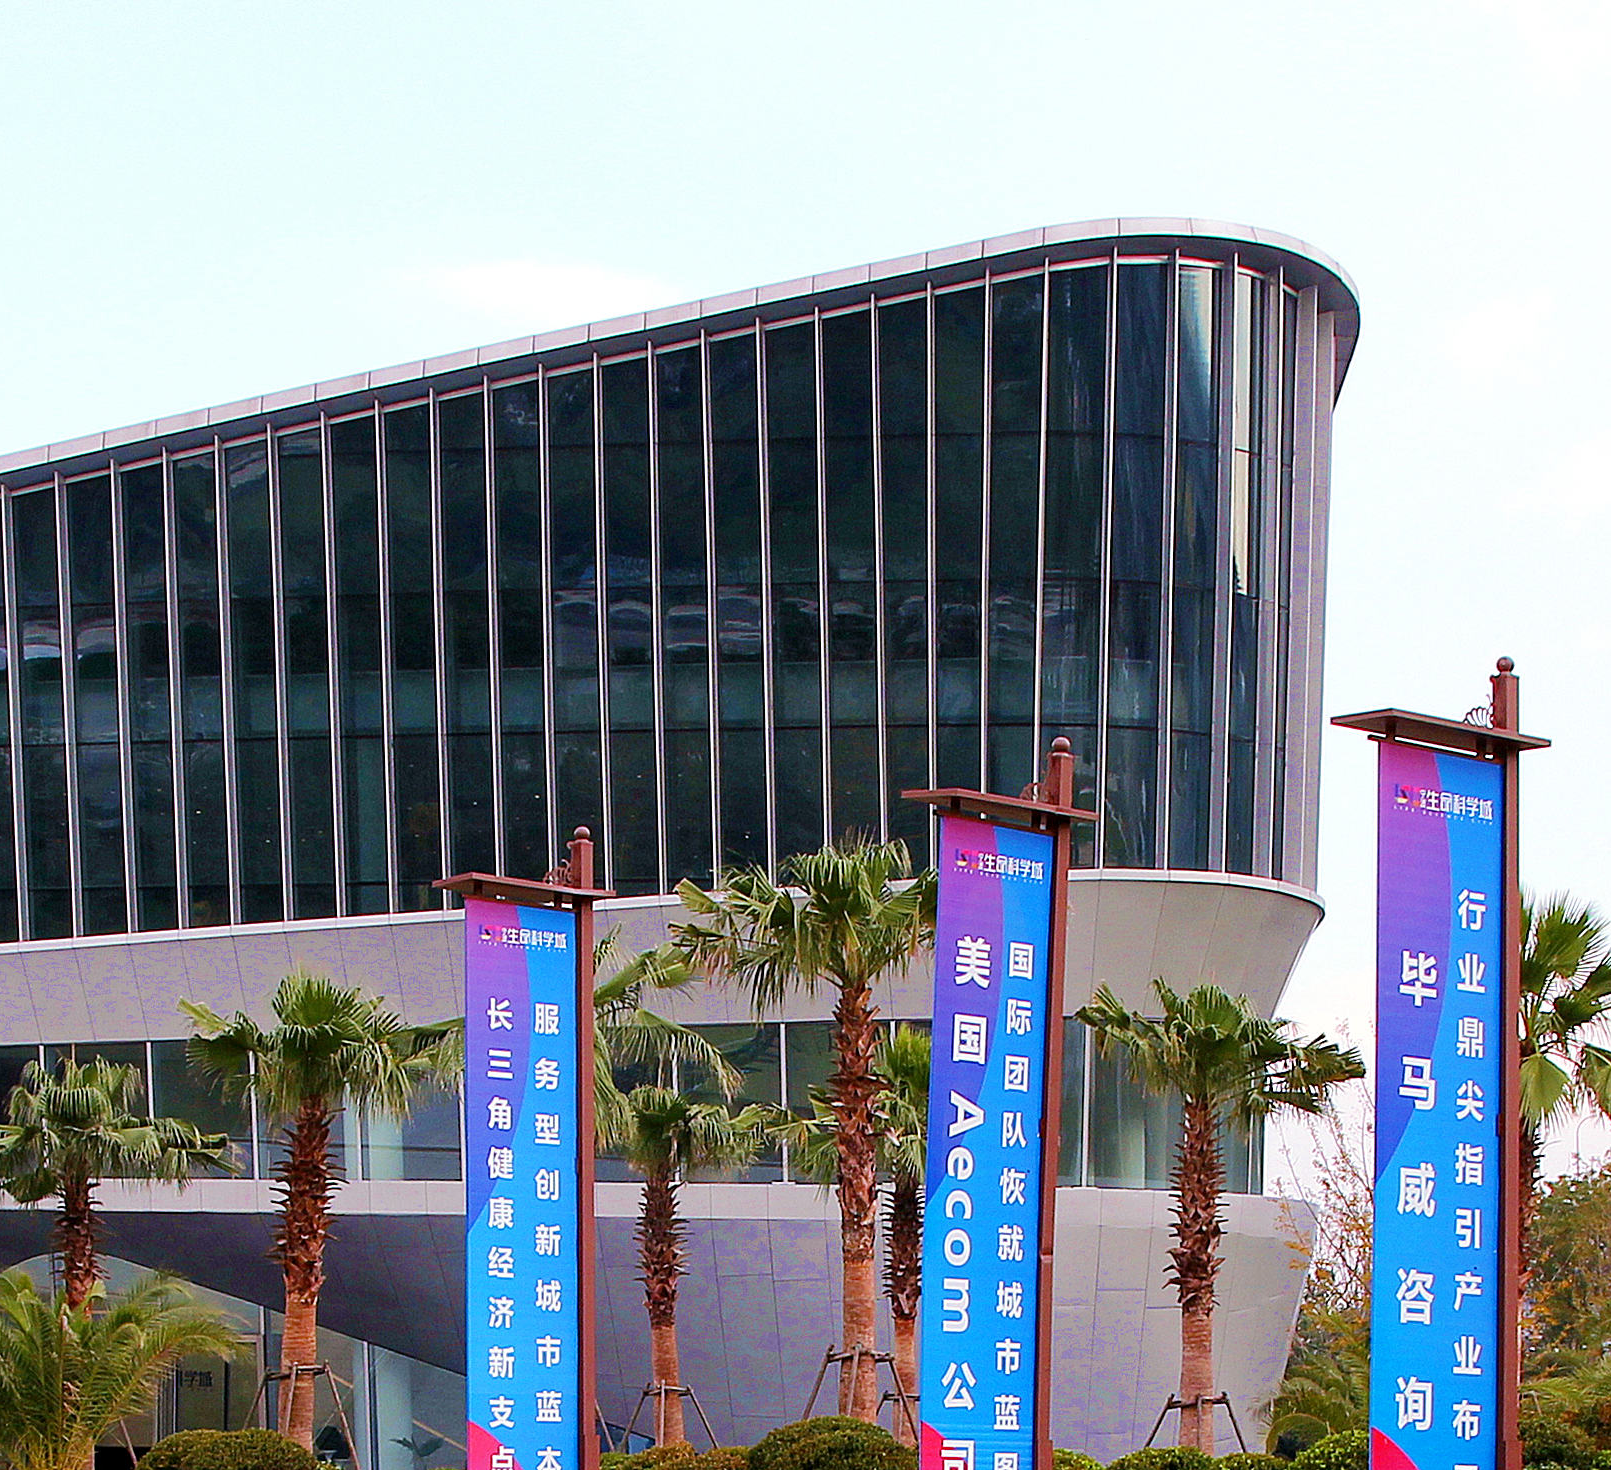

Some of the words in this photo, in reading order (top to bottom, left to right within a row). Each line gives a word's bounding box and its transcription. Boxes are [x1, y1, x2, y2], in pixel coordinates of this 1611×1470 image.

[1394, 949, 1438, 1431] 毕马威咨询
